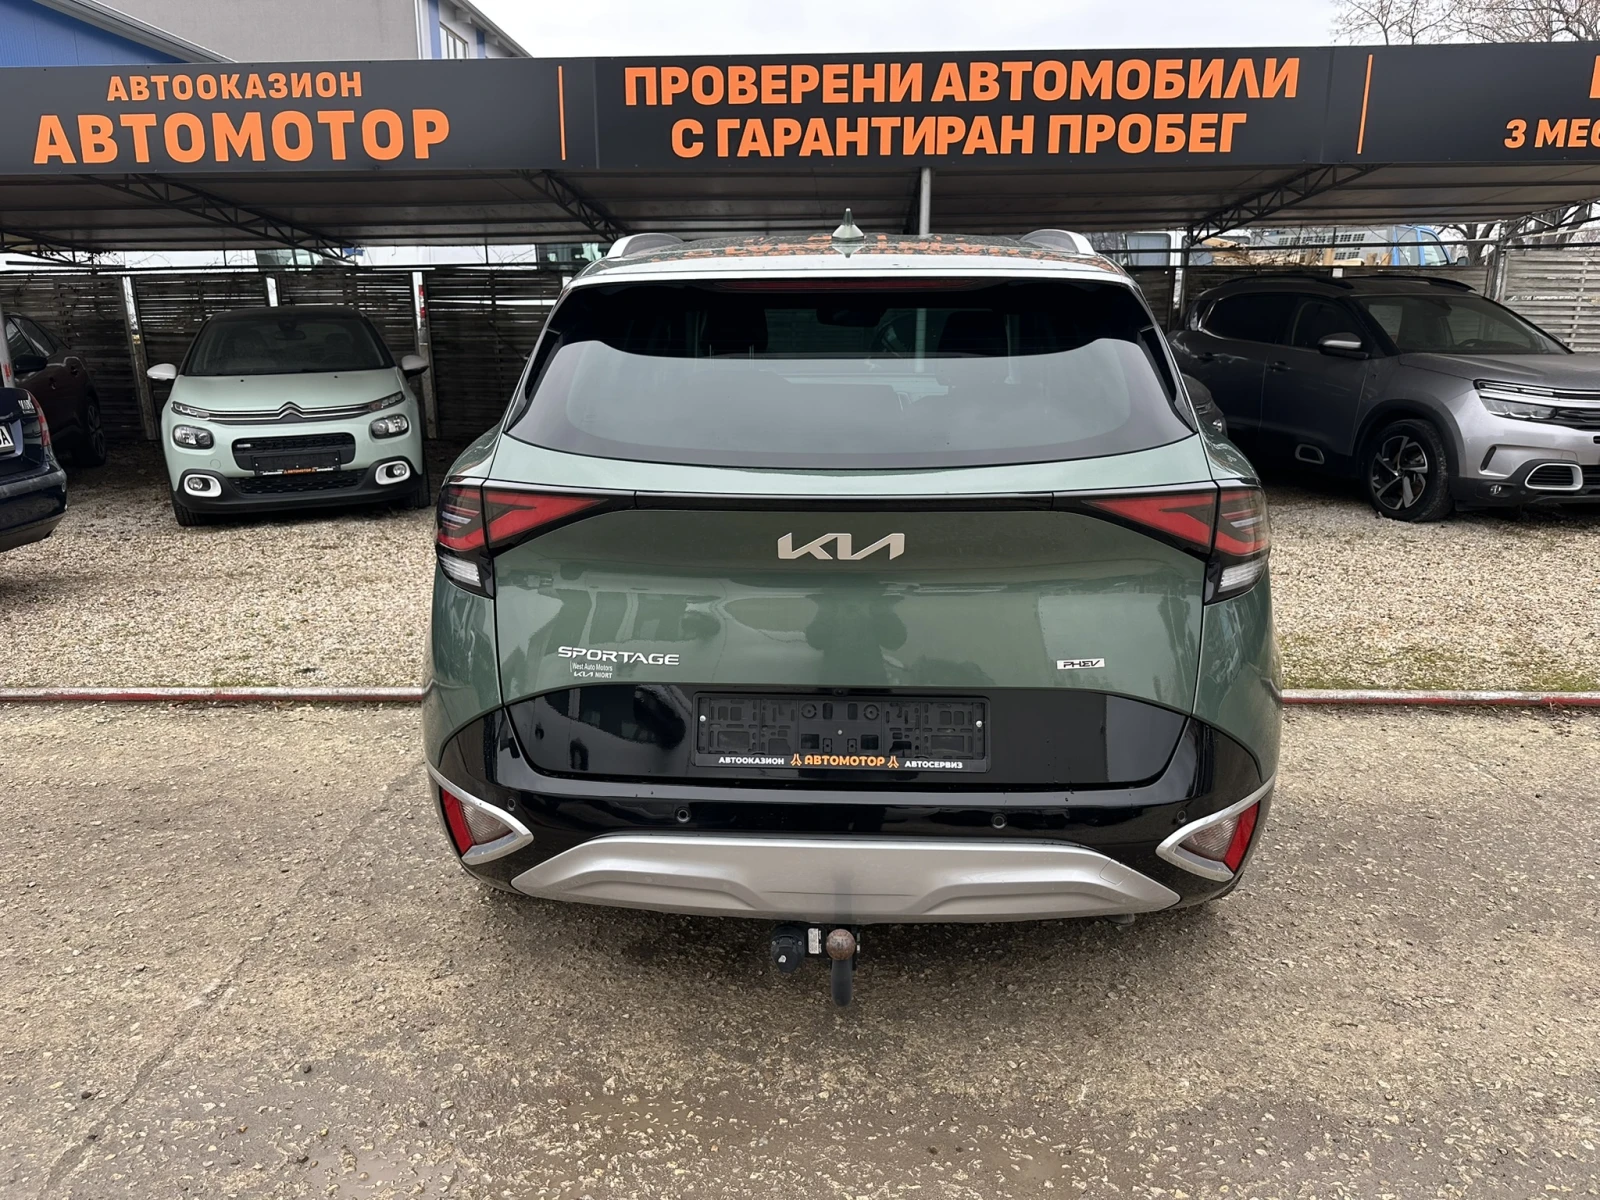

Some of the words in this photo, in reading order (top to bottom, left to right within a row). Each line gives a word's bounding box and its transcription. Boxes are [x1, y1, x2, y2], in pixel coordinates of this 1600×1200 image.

[106, 71, 362, 102] АВТООКАЗИОН
[624, 62, 923, 106] ПРОВЕРЕНИ
[931, 57, 1300, 102] АВТОМОБИЛИ
[33, 108, 450, 164] АВТОМОТОР
[671, 118, 704, 158] С
[717, 115, 1034, 157] ГАРАНТИРАН
[1047, 113, 1247, 154] ПРОБЕГ
[1504, 119, 1527, 149] 3
[777, 532, 905, 560] KIA
[557, 645, 680, 666] SPORTAGE
[572, 662, 584, 670] West
[584, 663, 595, 671] Auto
[595, 663, 613, 672] Motors
[1063, 659, 1101, 668] PHEV
[718, 756, 785, 765] АВТООКАЗИОН
[804, 754, 886, 767] АВТОМОТОР
[904, 760, 963, 769] АВТОСЕРВИЗ
